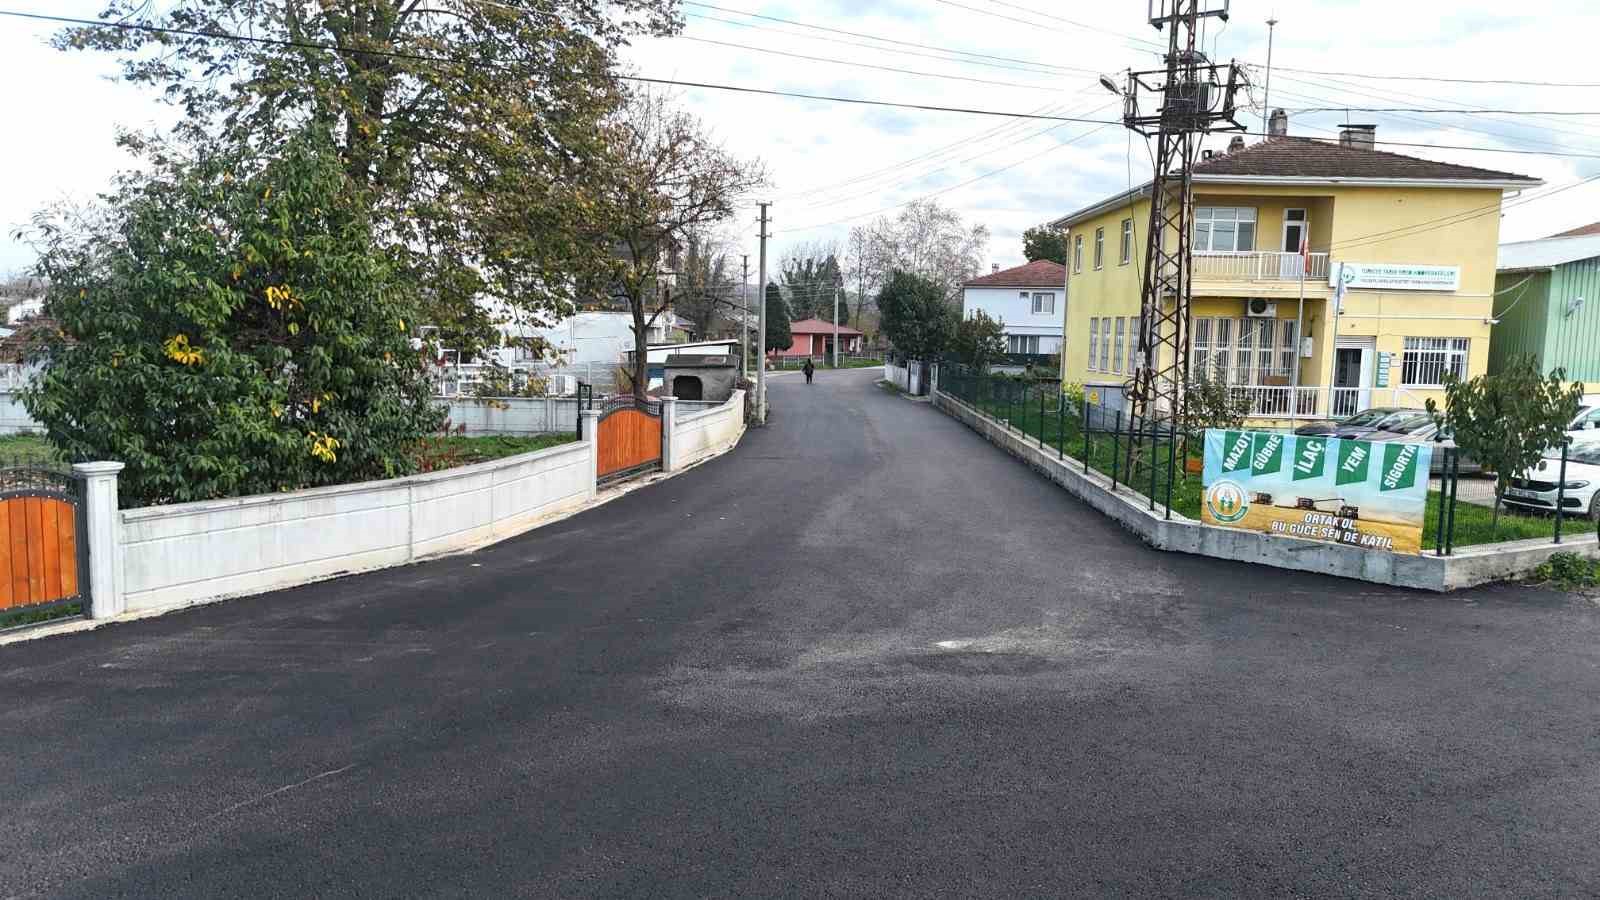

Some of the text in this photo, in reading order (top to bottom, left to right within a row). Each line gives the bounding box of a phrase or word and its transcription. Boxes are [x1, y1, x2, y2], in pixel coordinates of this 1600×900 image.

[1223, 432, 1252, 471] MAZOT
[1253, 434, 1281, 470] GÜBRE
[1294, 440, 1325, 474] İLAÇ
[1341, 446, 1367, 473] YEM
[1384, 444, 1417, 489] SİGORTA
[1271, 520, 1286, 532] BU
[1320, 527, 1341, 540] SEN
[1343, 531, 1359, 543] DE
[1304, 512, 1339, 527] ORTAK
